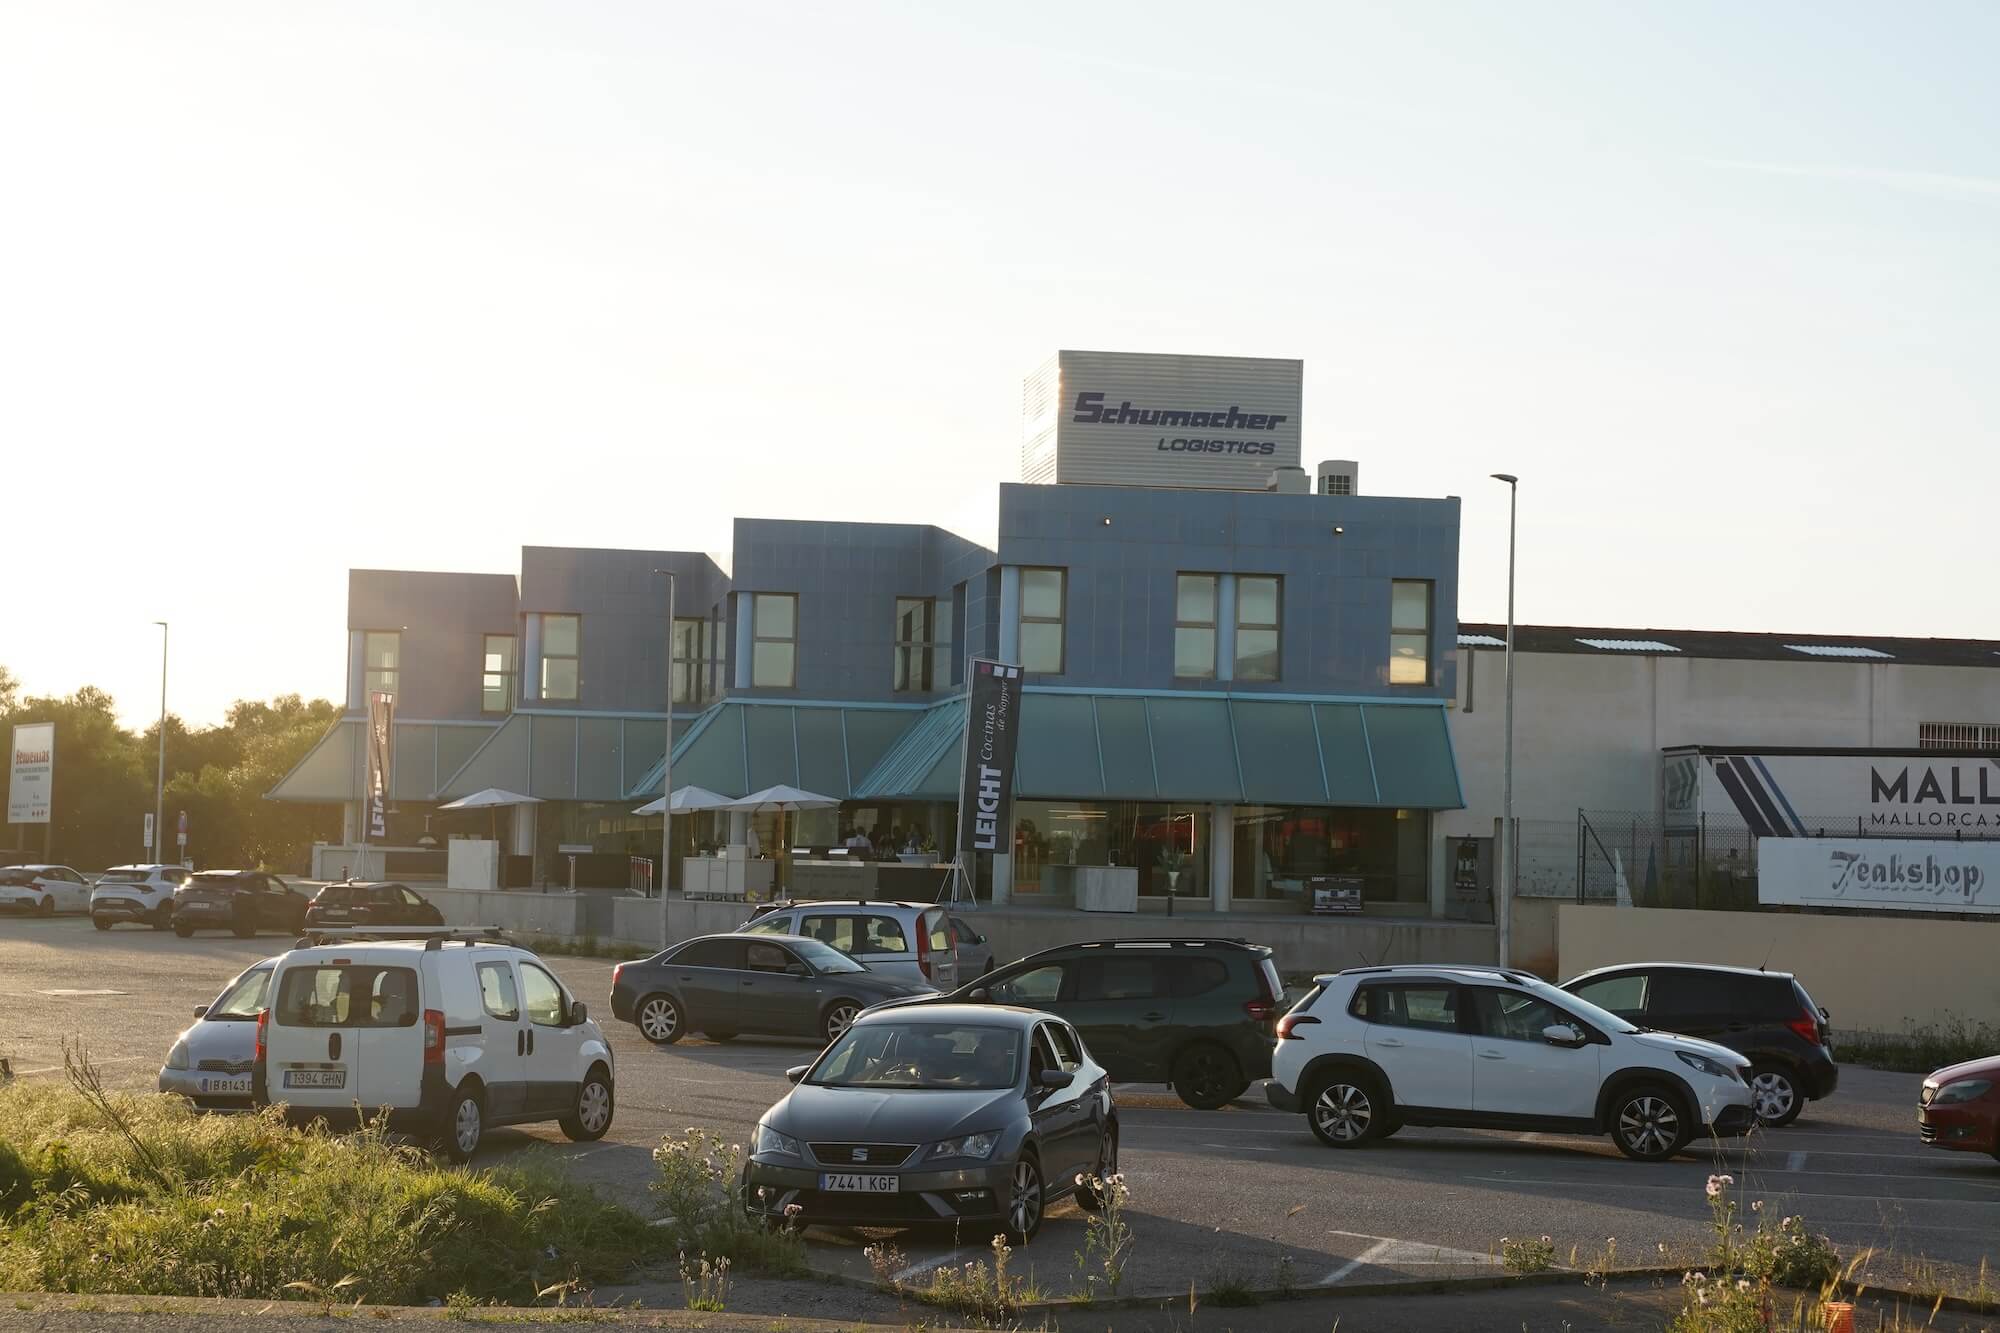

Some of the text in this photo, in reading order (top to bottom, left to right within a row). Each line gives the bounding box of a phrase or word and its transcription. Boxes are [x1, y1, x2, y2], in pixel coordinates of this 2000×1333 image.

[1073, 392, 1286, 430] Schumacher
[1158, 438, 1275, 455] LOGISTICS
[995, 715, 1005, 731] de
[974, 704, 1002, 850] LEICHT Cocinas
[1872, 766, 2000, 804] MALL
[1872, 812, 1987, 826] MALLORCA
[1830, 851, 1982, 898] Teakshop
[222, 1079, 246, 1091] 8143
[828, 1175, 897, 1191] 7441 KGF
